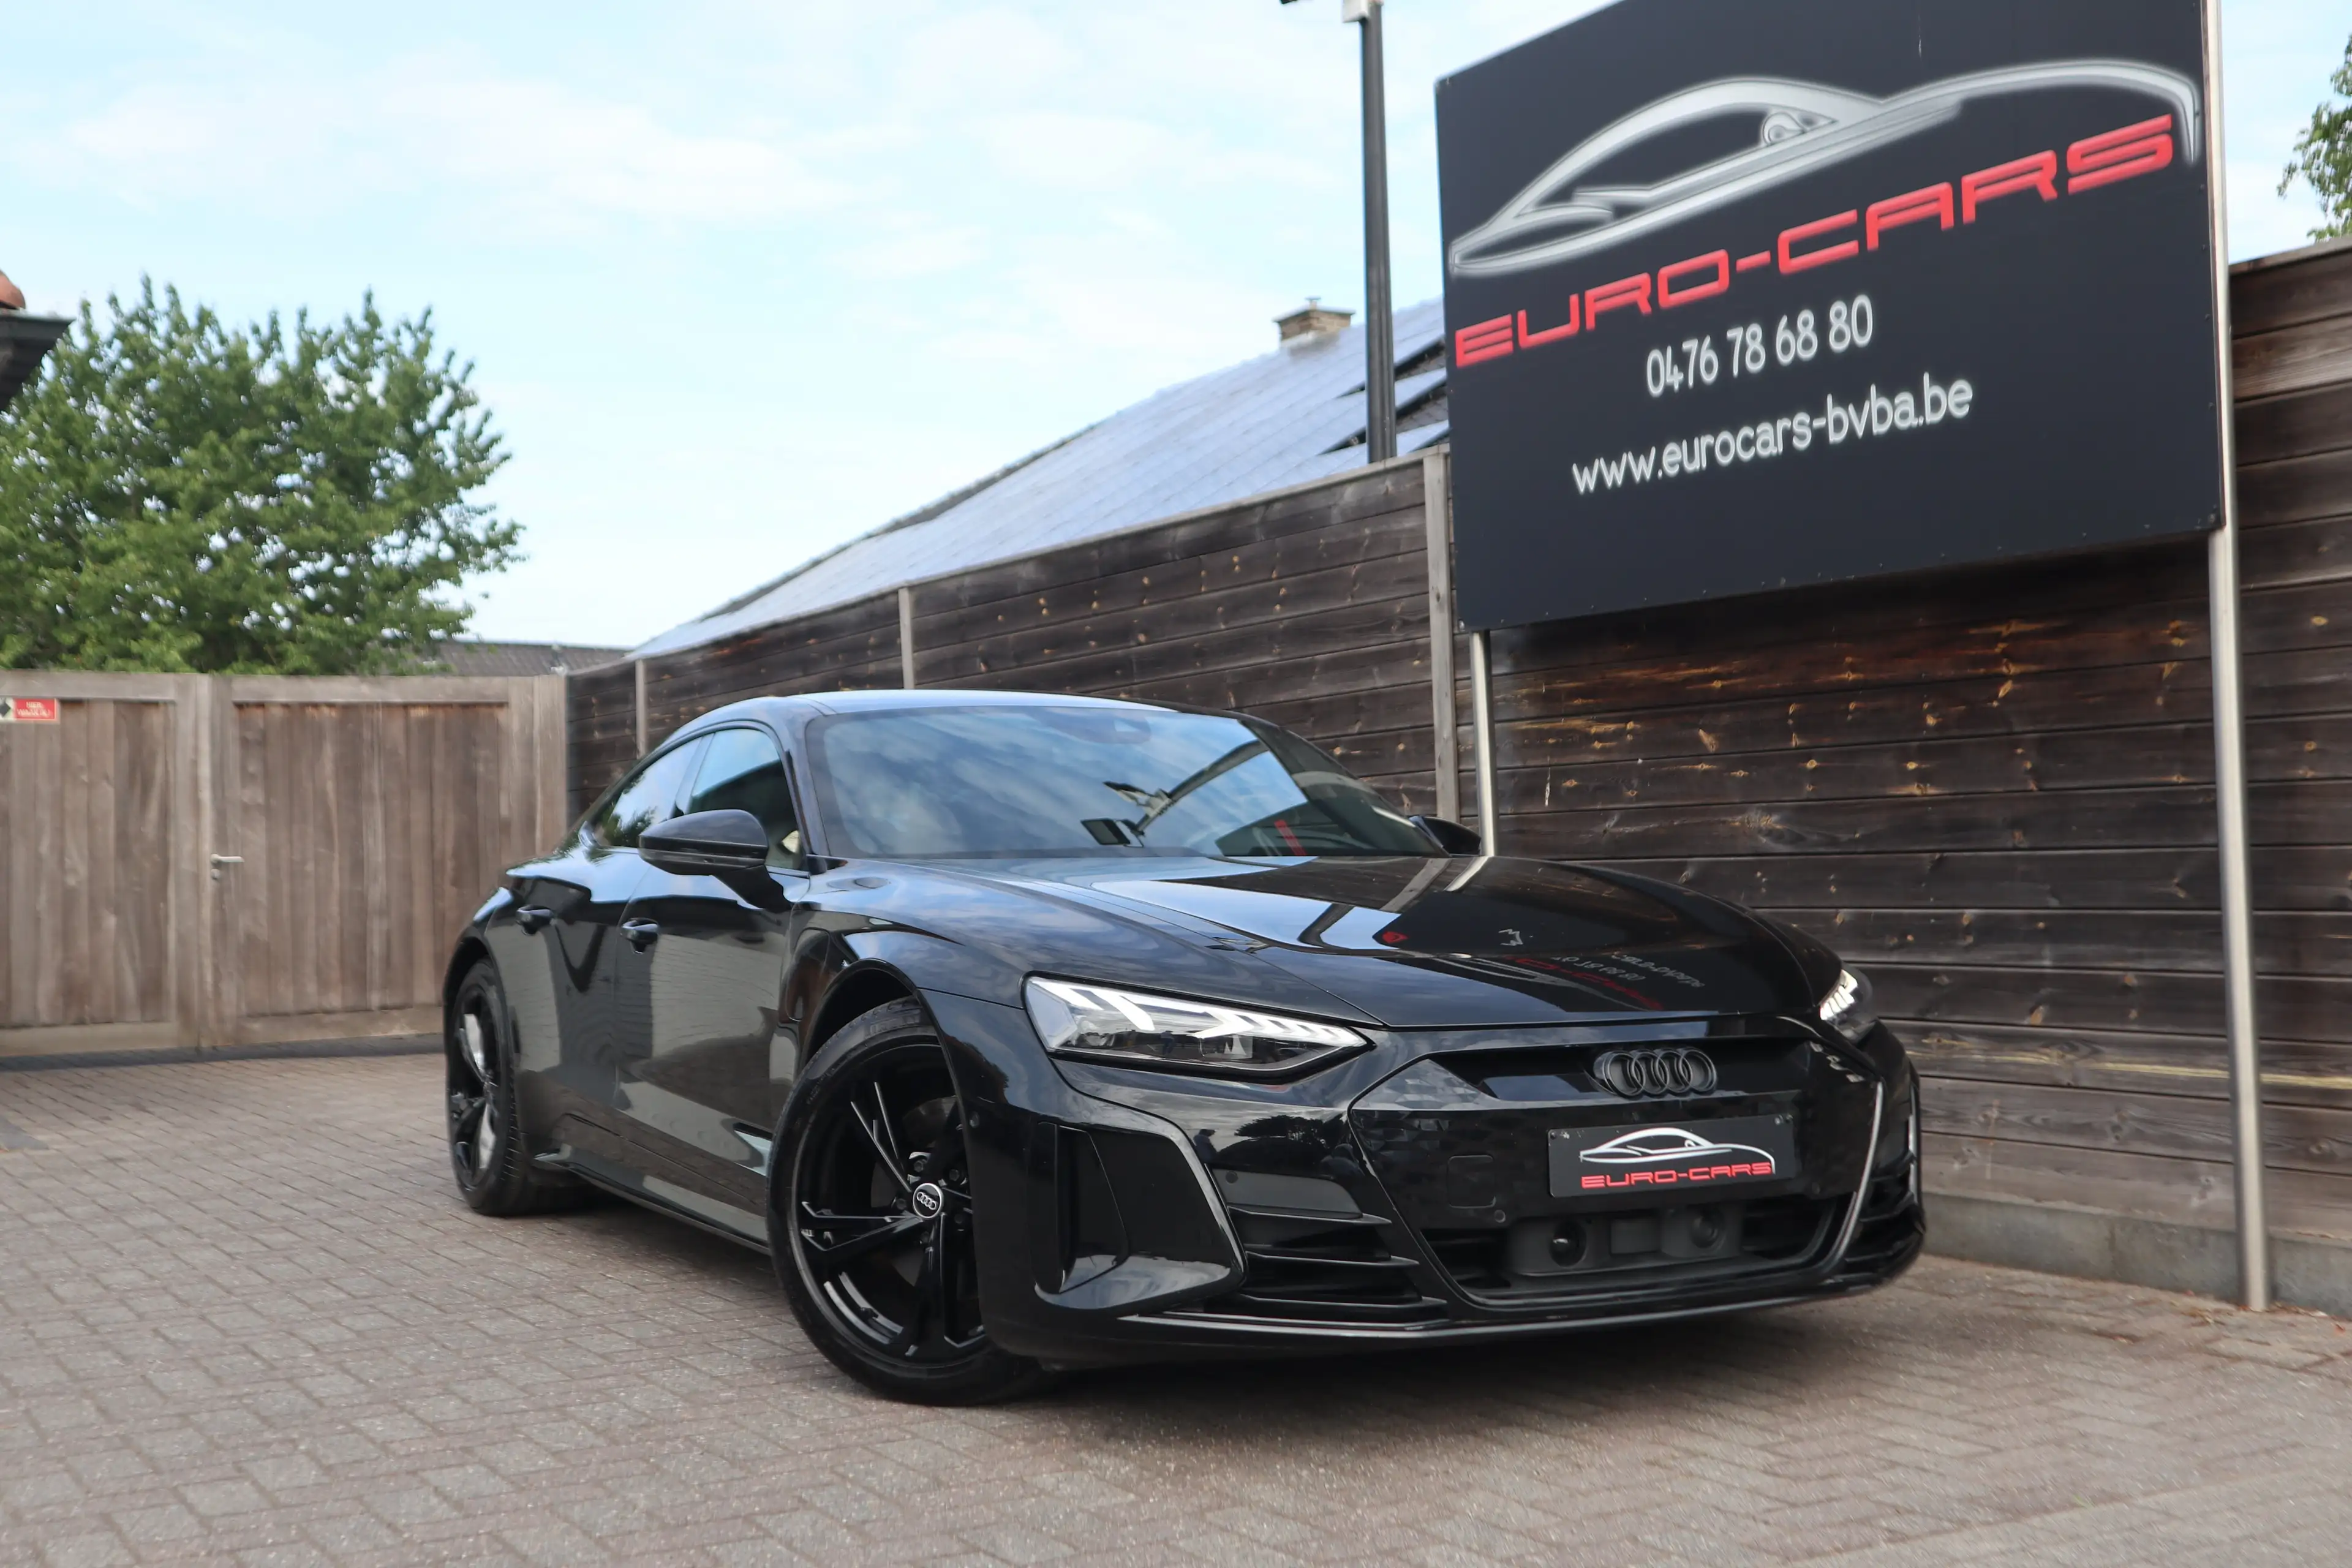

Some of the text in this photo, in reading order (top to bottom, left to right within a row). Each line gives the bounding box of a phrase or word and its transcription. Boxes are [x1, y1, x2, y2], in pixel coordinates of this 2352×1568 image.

[1455, 114, 2174, 368] EURO-CARS
[1646, 294, 1874, 397] 0476 78 68 80
[1572, 371, 1973, 494] www.eurocars-bvba.be
[1581, 1161, 1772, 1189] EURO-CARS
